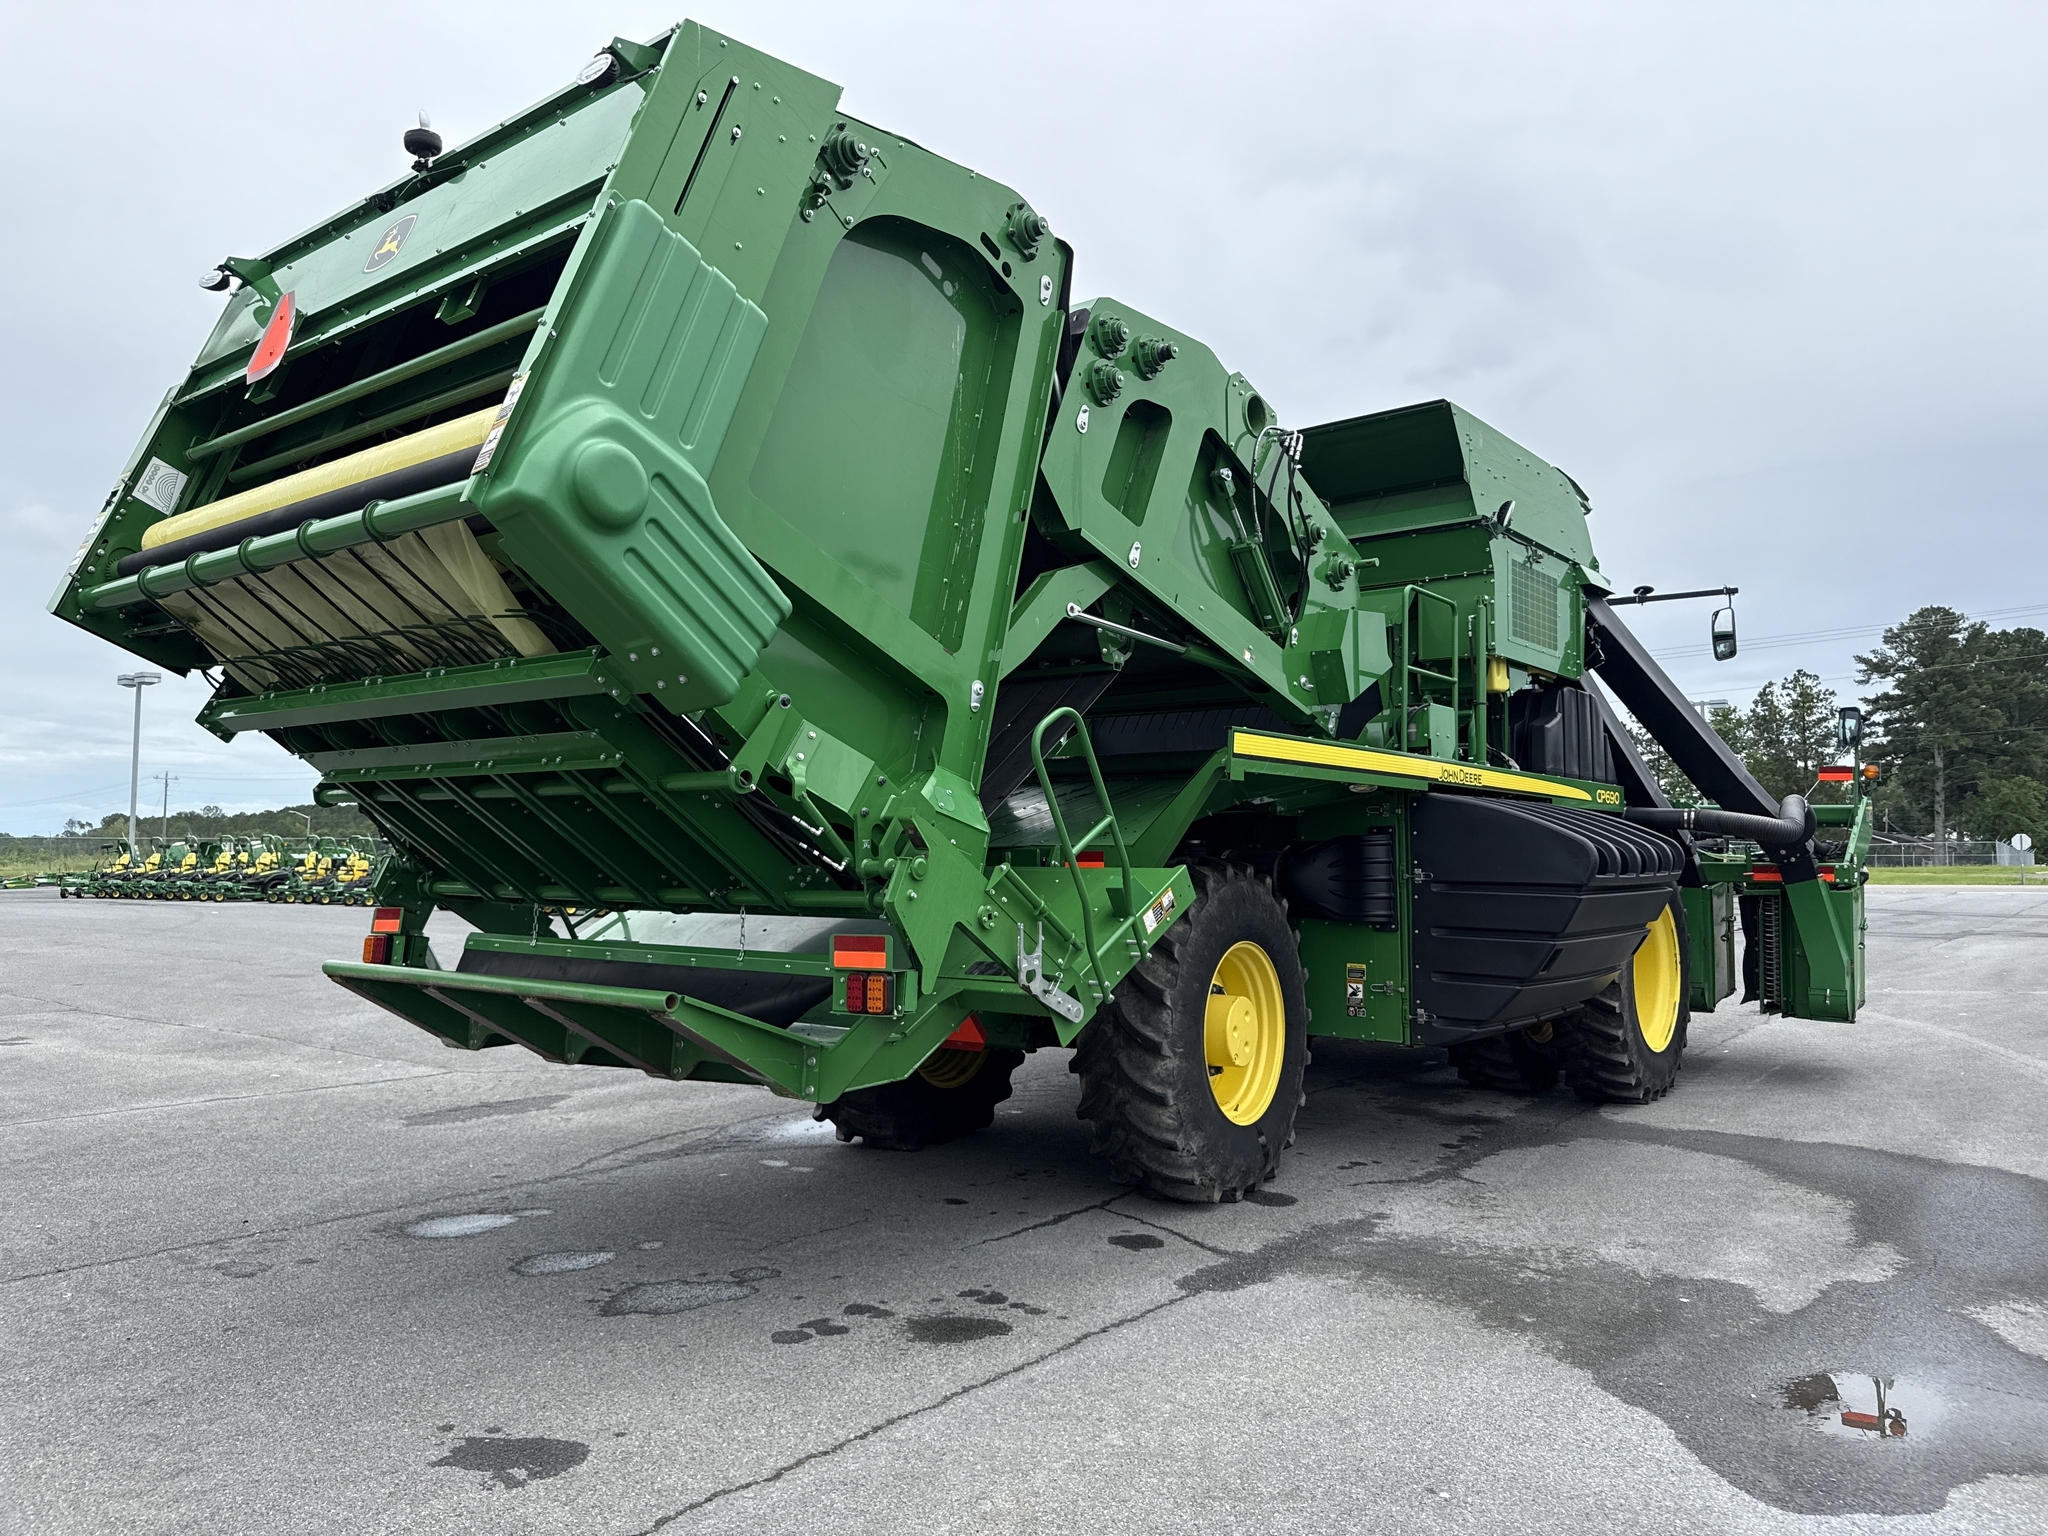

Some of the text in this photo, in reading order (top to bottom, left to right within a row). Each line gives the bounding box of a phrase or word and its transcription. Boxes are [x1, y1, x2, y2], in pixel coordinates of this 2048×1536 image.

[1438, 766, 1483, 785] JOHN DEERE
[1596, 789, 1620, 805] CP690
